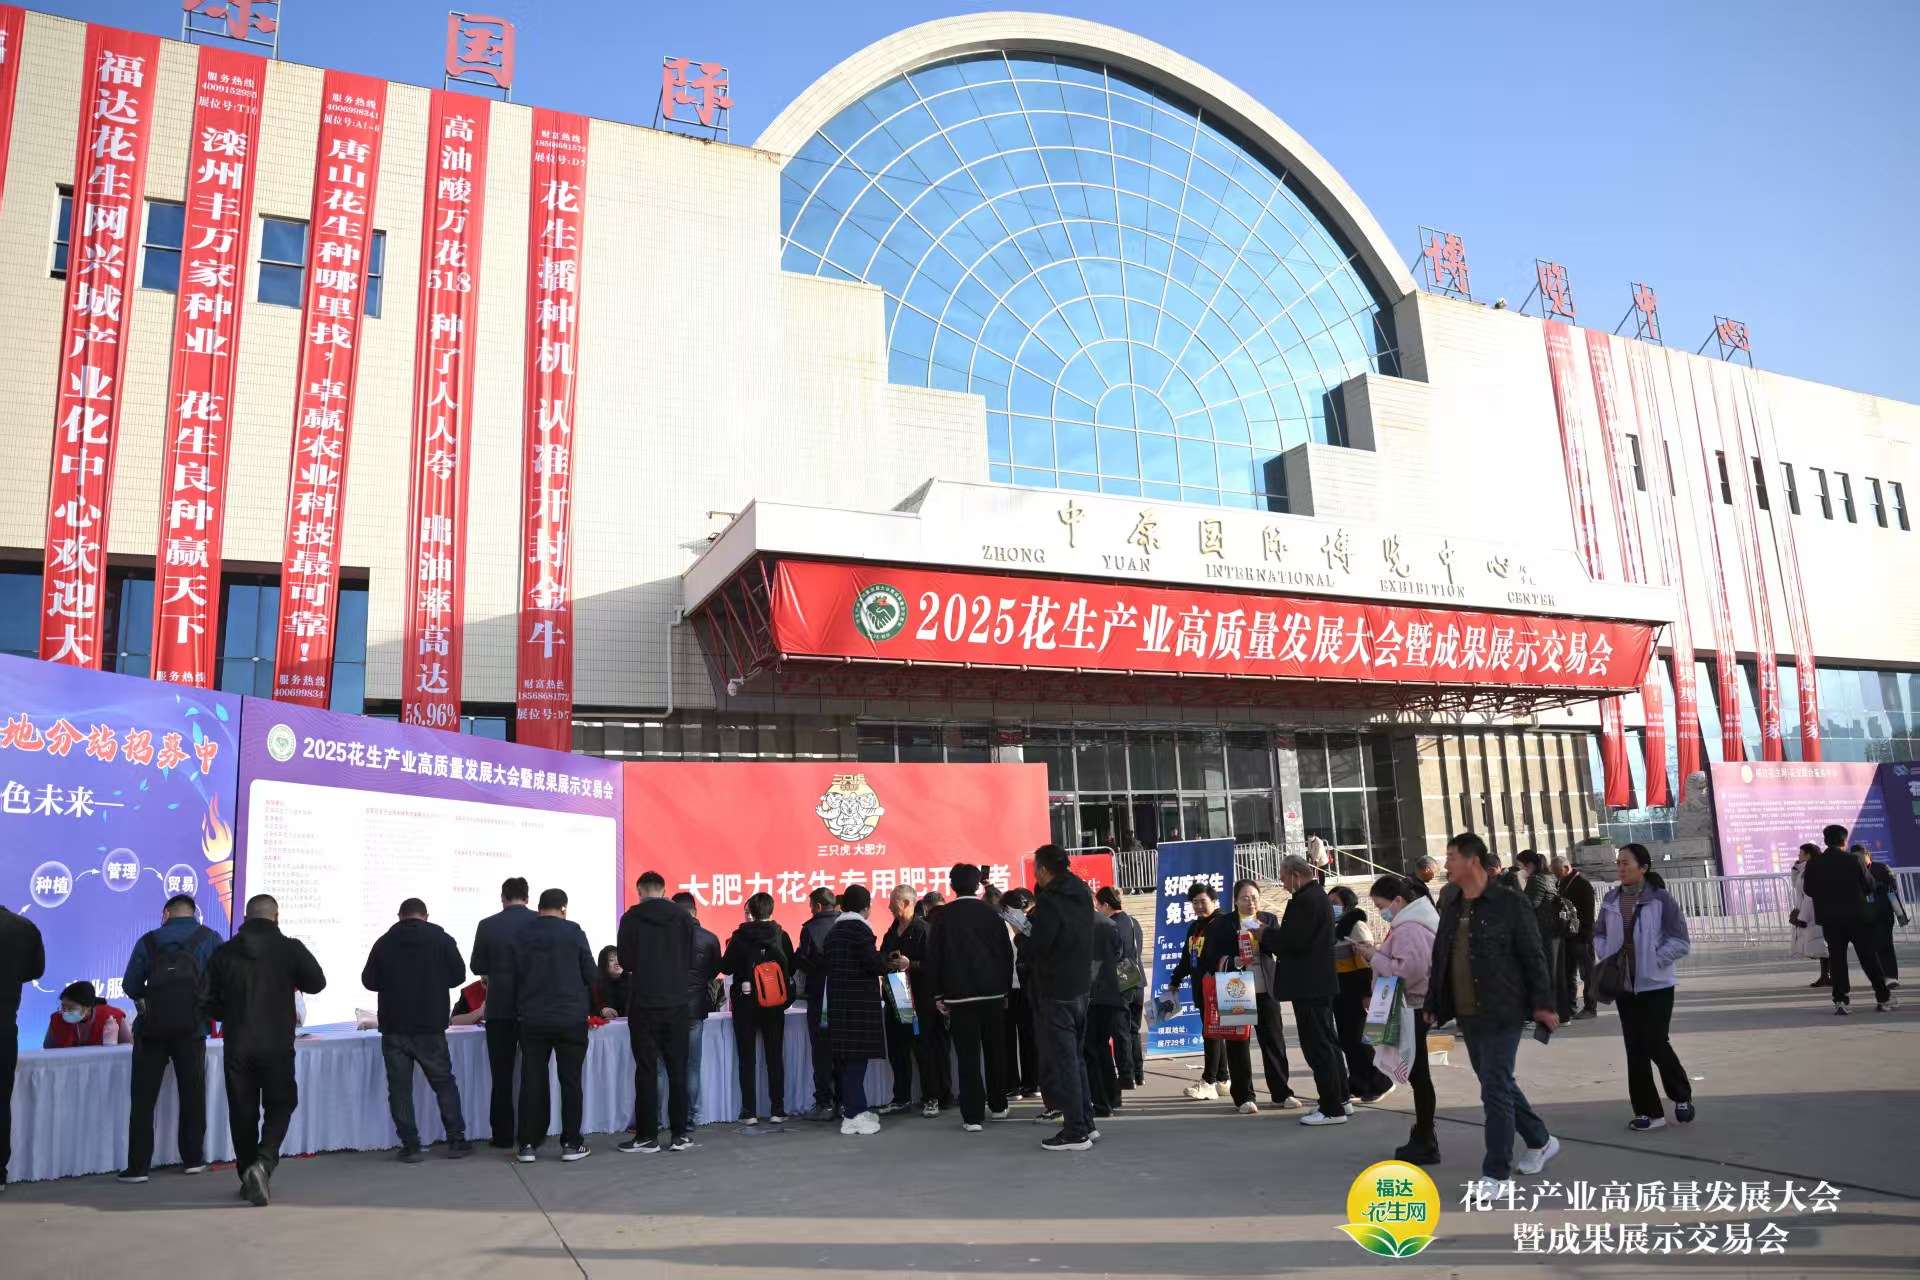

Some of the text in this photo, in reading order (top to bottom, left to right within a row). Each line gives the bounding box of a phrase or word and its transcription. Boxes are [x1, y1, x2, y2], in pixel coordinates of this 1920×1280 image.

[527, 179, 580, 658] 花生播种机 认准开封金牛
[162, 390, 224, 644] 花生良种赢天下
[982, 545, 1555, 606] ZHONG YUAN INTERNATIONAL EXHIBITION CENTER
[915, 591, 1613, 676] 2025花生产业高质量发展大会暨成果展示交易会
[279, 674, 325, 687] 服务热线
[303, 737, 614, 800] 2025花生产业高质量发展大会暨成果展示交易会
[107, 862, 137, 880] 管理
[817, 843, 886, 857] 三只虎 大肥力
[35, 875, 69, 894] 种植
[167, 876, 194, 893] 贸易
[678, 864, 1010, 906] 大肥力花生专用肥开者
